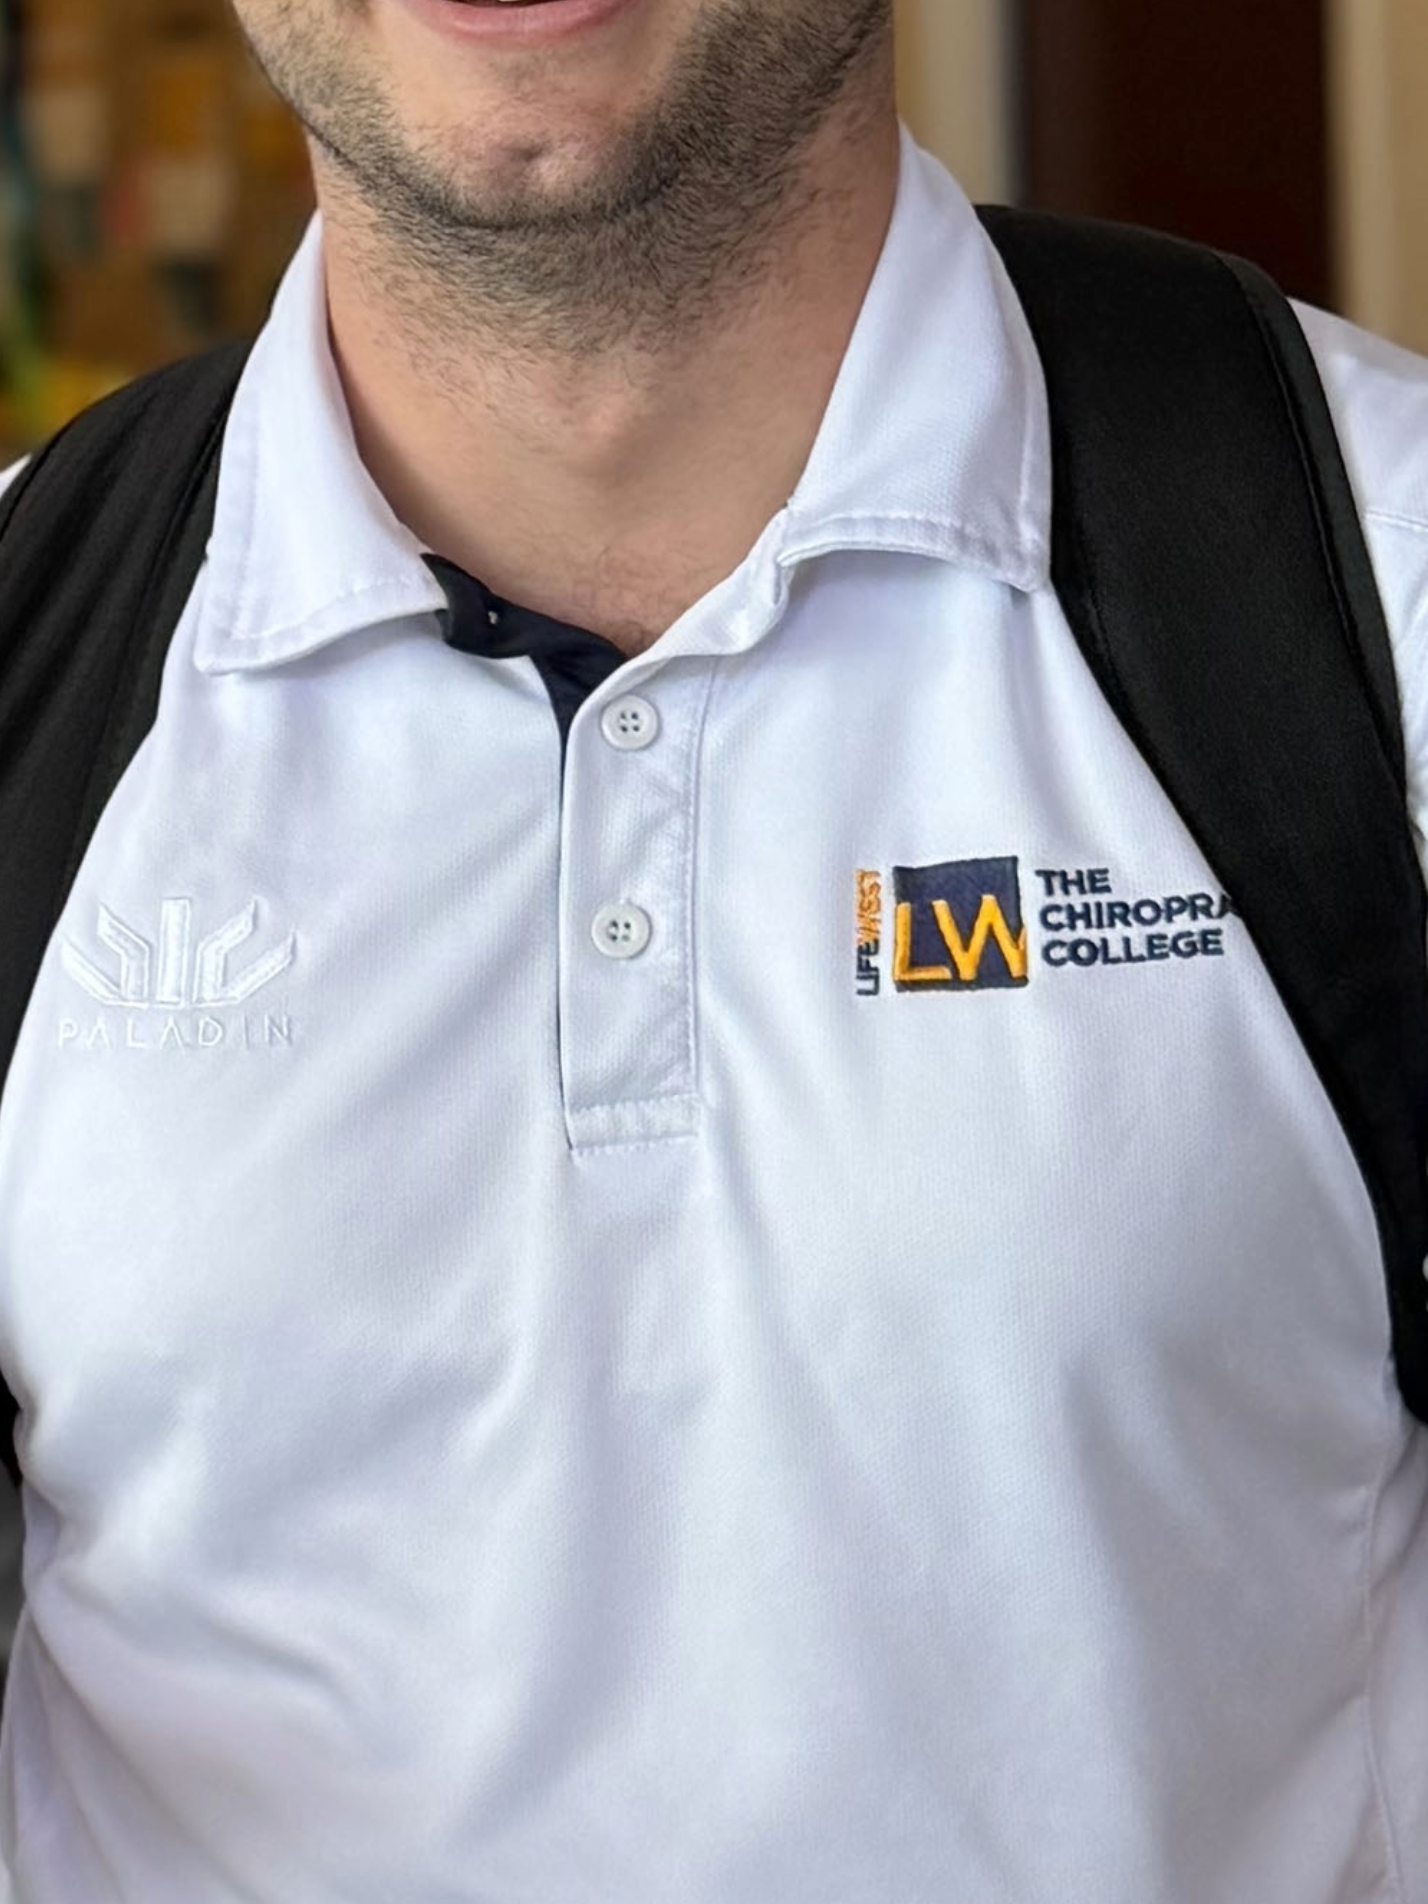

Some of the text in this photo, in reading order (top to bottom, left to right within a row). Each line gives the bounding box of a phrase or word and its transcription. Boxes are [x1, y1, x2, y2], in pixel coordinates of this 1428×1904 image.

[1035, 867, 1112, 897] THE
[893, 893, 1028, 982] LW
[1041, 928, 1225, 969] COLLEGE
[57, 1014, 292, 1050] PALADIN
